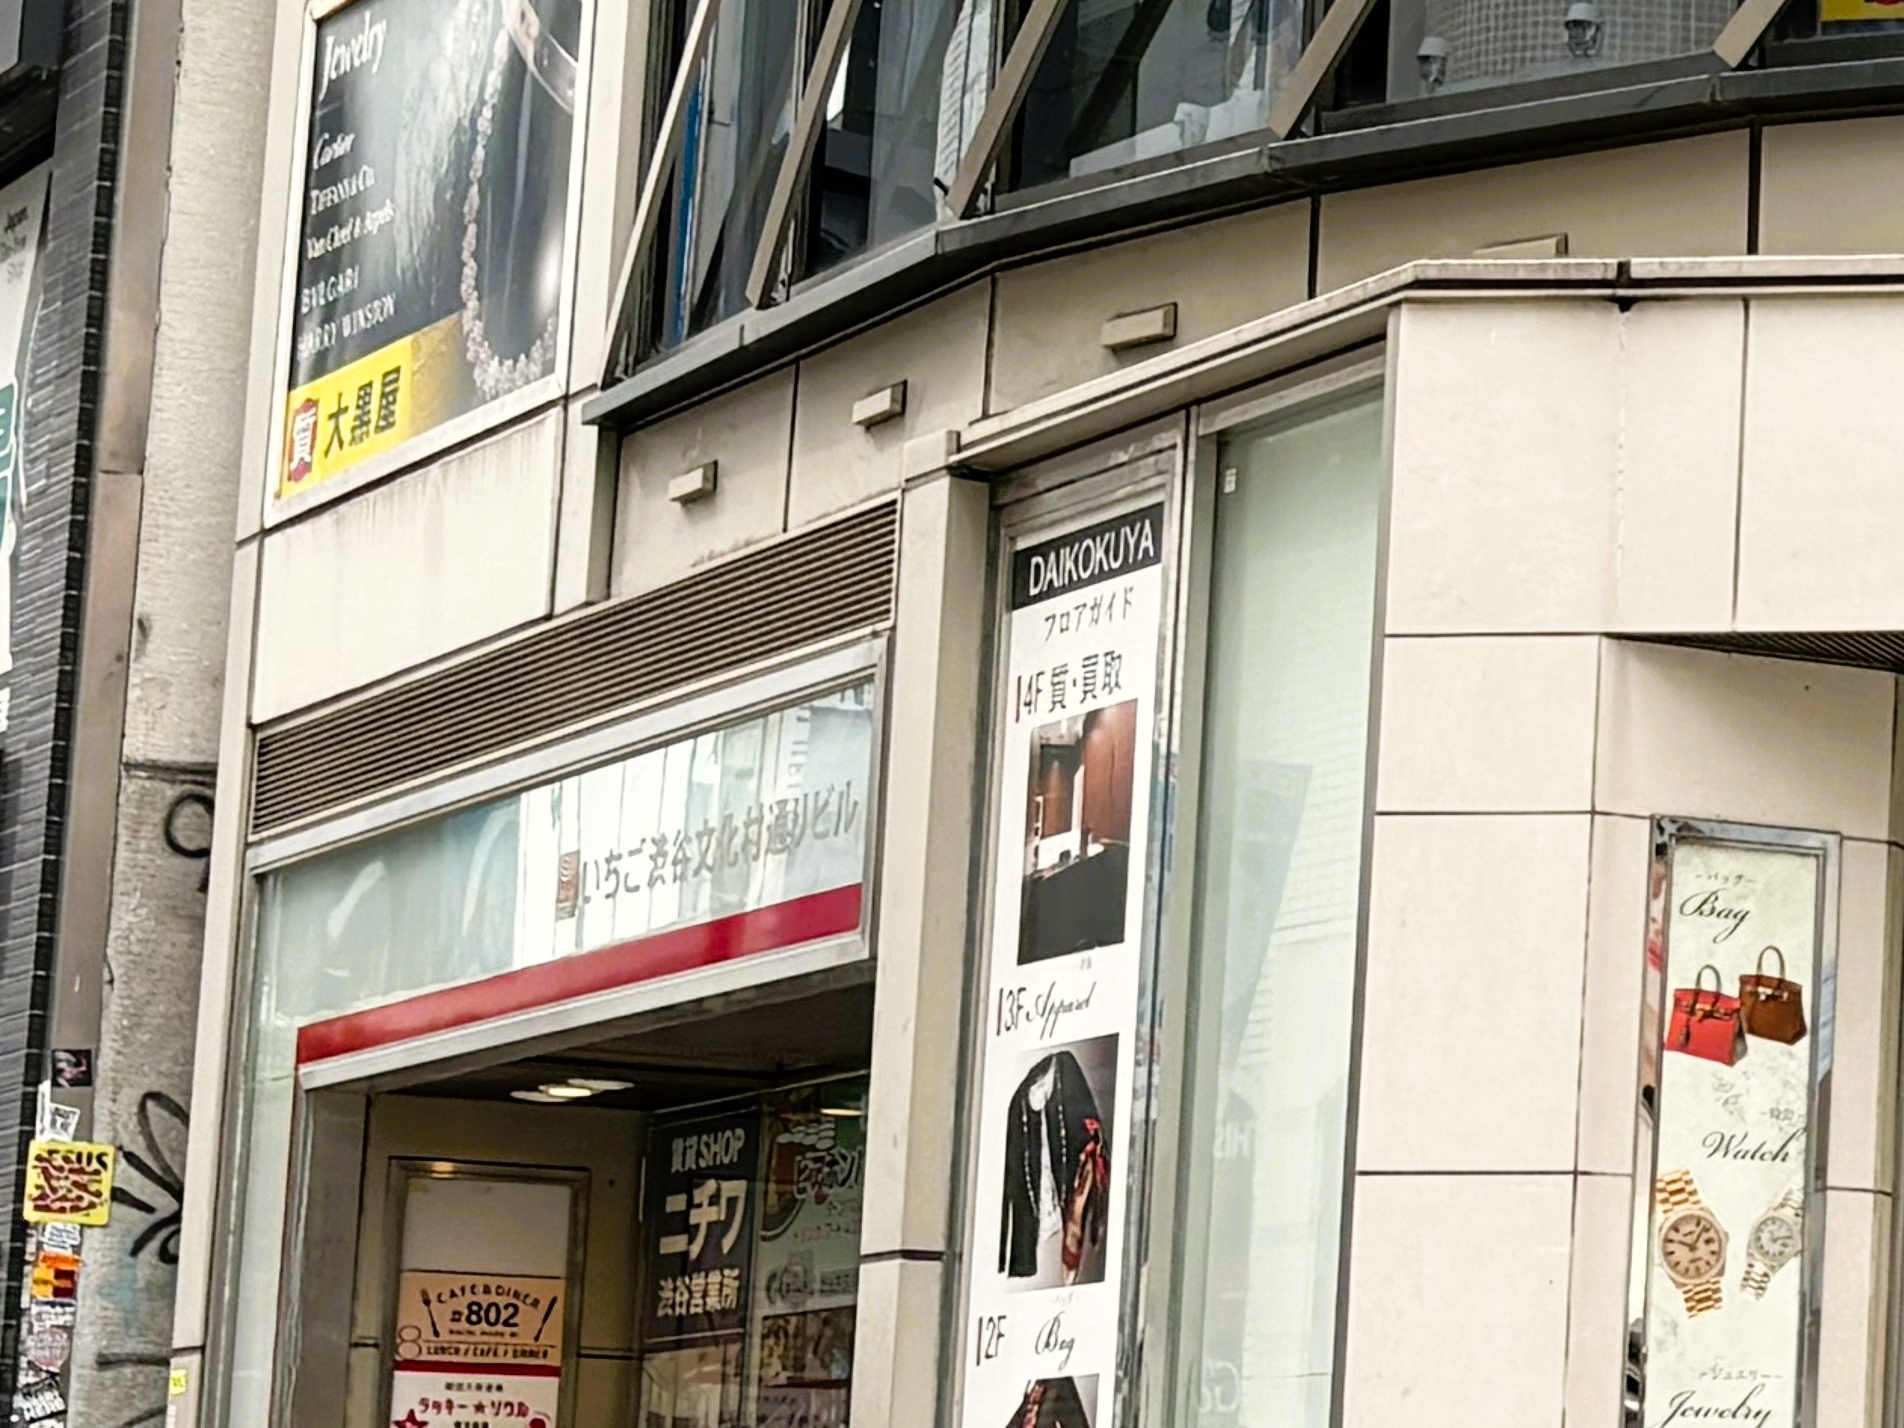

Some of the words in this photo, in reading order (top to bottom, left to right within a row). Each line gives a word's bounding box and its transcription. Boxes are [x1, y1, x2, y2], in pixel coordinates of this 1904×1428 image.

[319, 11, 387, 99] Jewelry
[324, 364, 402, 459] 大黒屋
[1028, 518, 1156, 597] DAIKOKUYA
[1043, 585, 1136, 643] フロアガイド
[1678, 888, 1752, 944] Bag
[1004, 988, 1026, 1036] 3F
[1026, 982, 1098, 1040] Apparel
[1701, 1124, 1808, 1165] Watch
[658, 1177, 749, 1262] ニチワ
[465, 1300, 520, 1328] 802
[984, 1315, 1008, 1365] 2F
[1034, 1309, 1076, 1370] Bag
